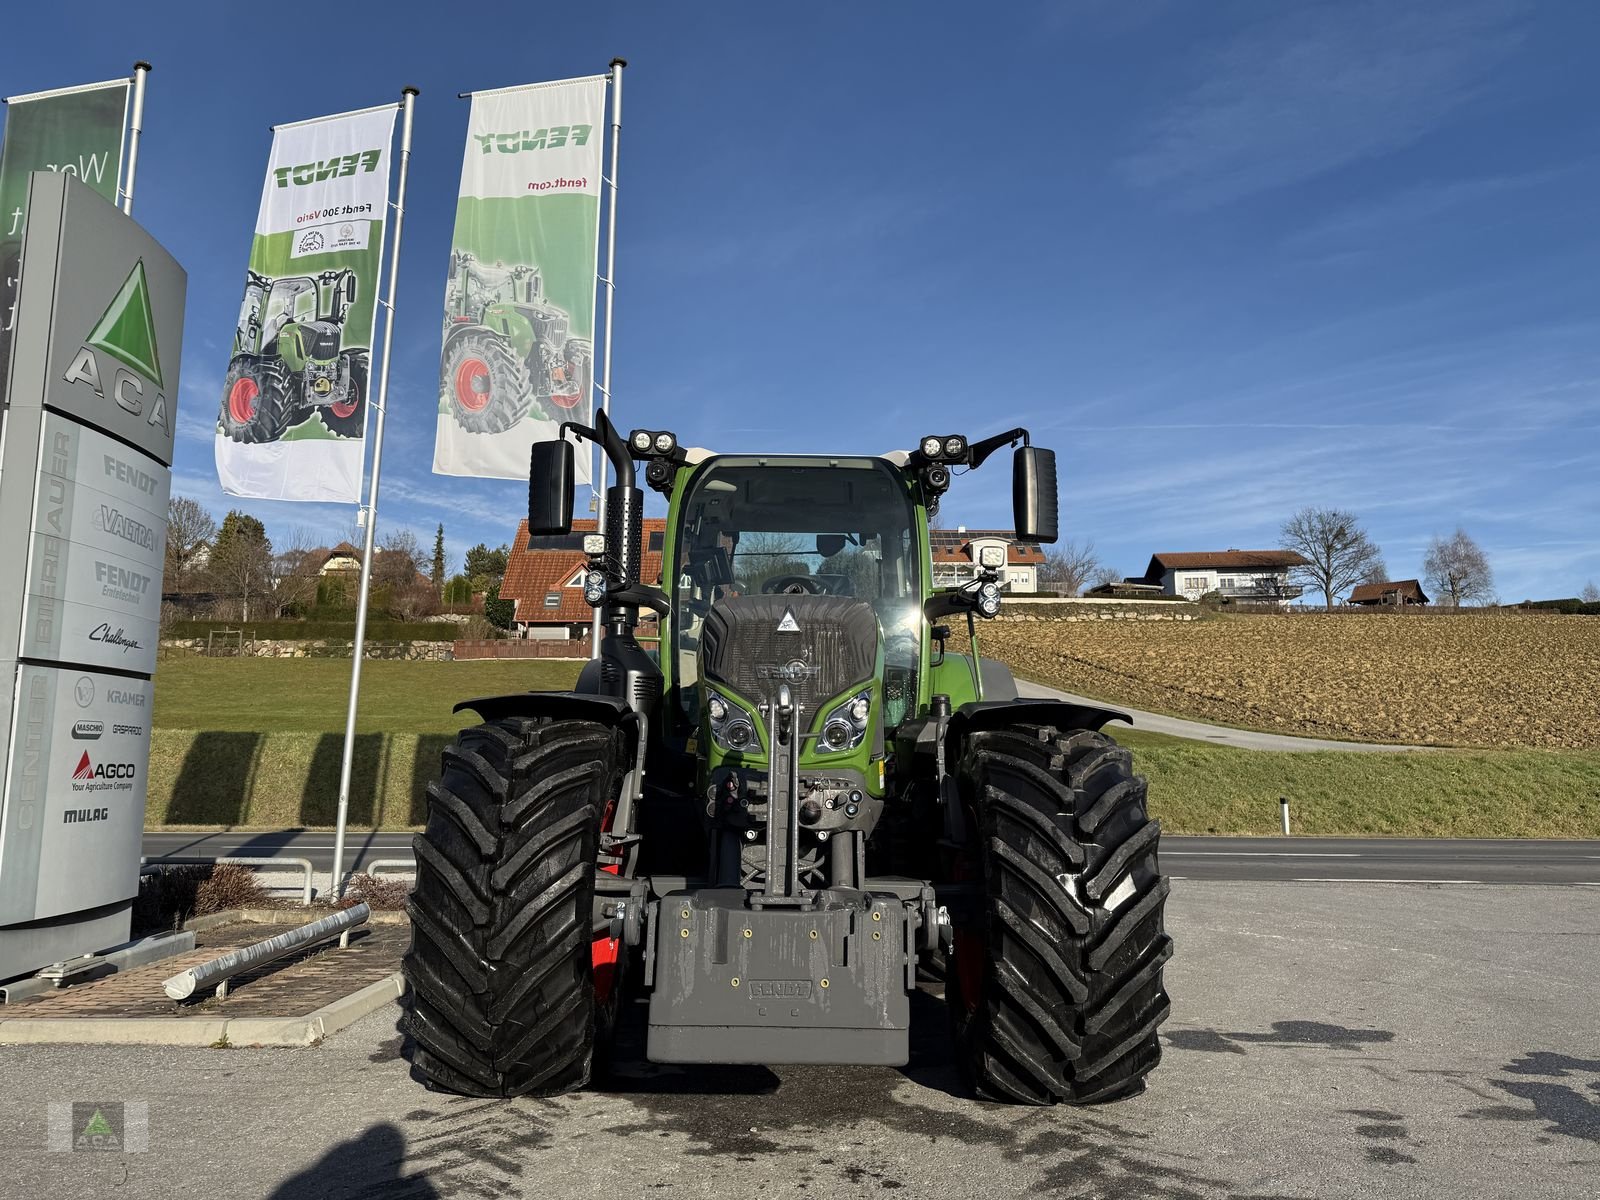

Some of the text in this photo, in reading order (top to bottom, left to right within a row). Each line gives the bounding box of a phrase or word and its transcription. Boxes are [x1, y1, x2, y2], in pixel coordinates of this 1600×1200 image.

[63, 346, 170, 439] ACA
[103, 454, 159, 496] FENDT
[100, 503, 154, 552] VALTRA
[94, 560, 151, 594] FENDT
[88, 622, 144, 653] Challenger
[107, 689, 146, 708] KRAMER
[76, 724, 103, 732] MASCHIO
[112, 724, 143, 736] GASPARDO
[94, 763, 136, 779] AGCO
[71, 781, 133, 793] Your Agriculture Company
[63, 807, 109, 824] MULAG
